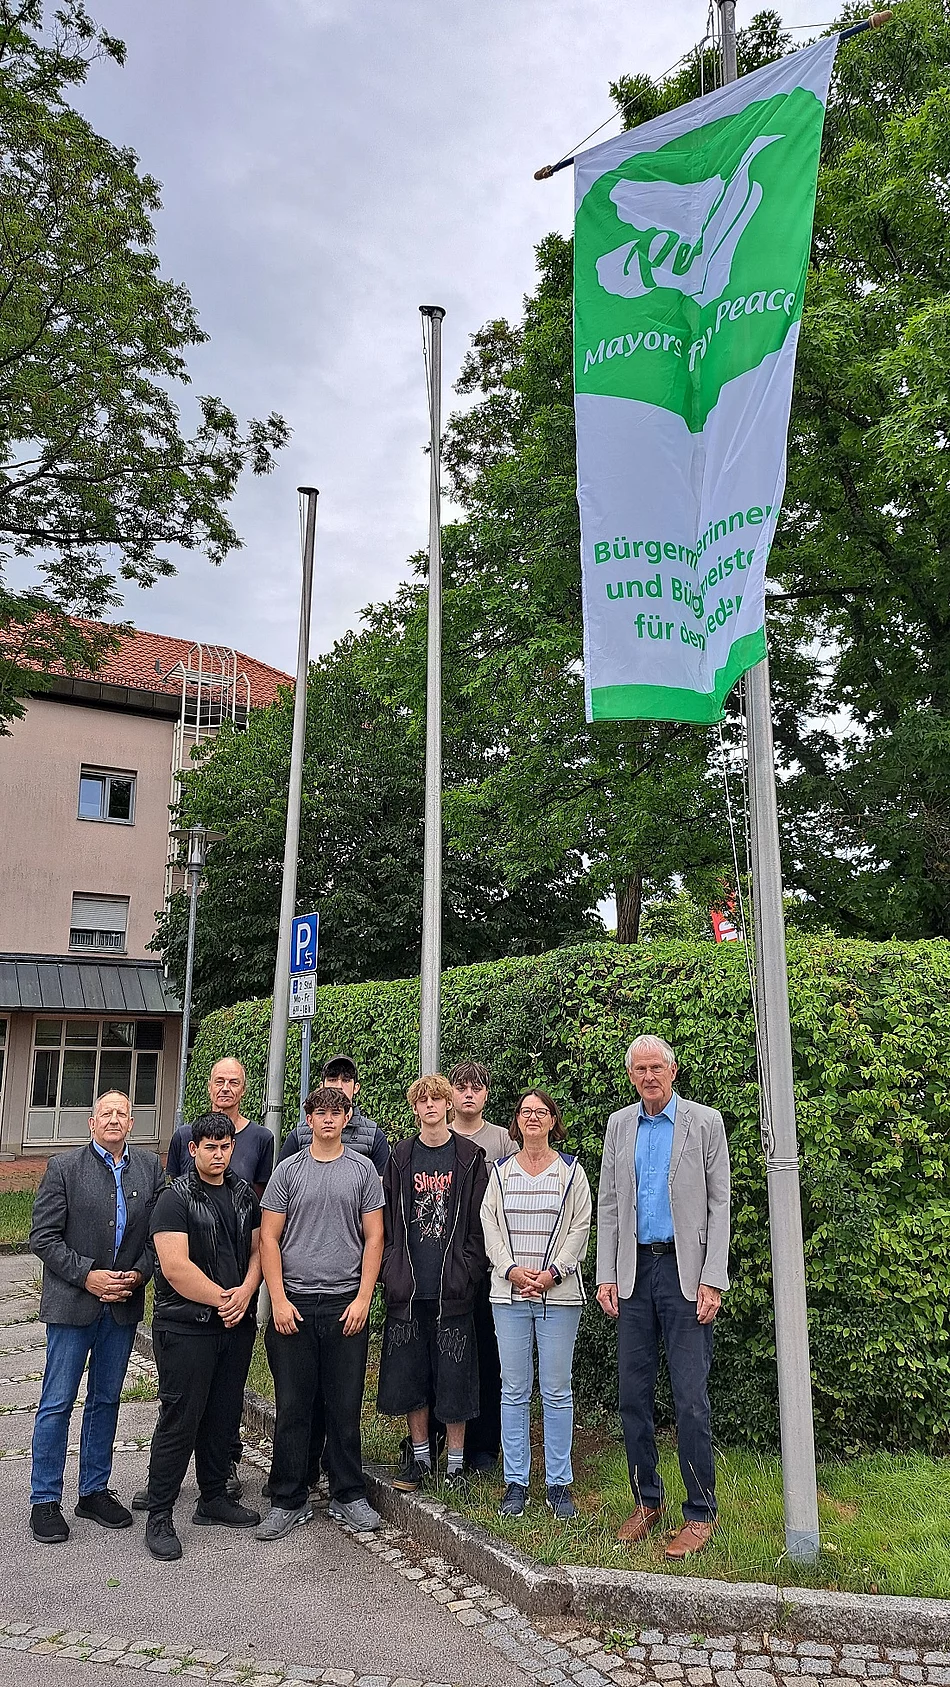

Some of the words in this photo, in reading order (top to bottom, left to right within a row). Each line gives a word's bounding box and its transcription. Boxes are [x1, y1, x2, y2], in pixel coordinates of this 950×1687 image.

[583, 330, 682, 374] Mayors
[606, 574, 663, 600] und
[634, 613, 675, 640] für
[680, 621, 706, 651] den
[296, 922, 311, 966] P
